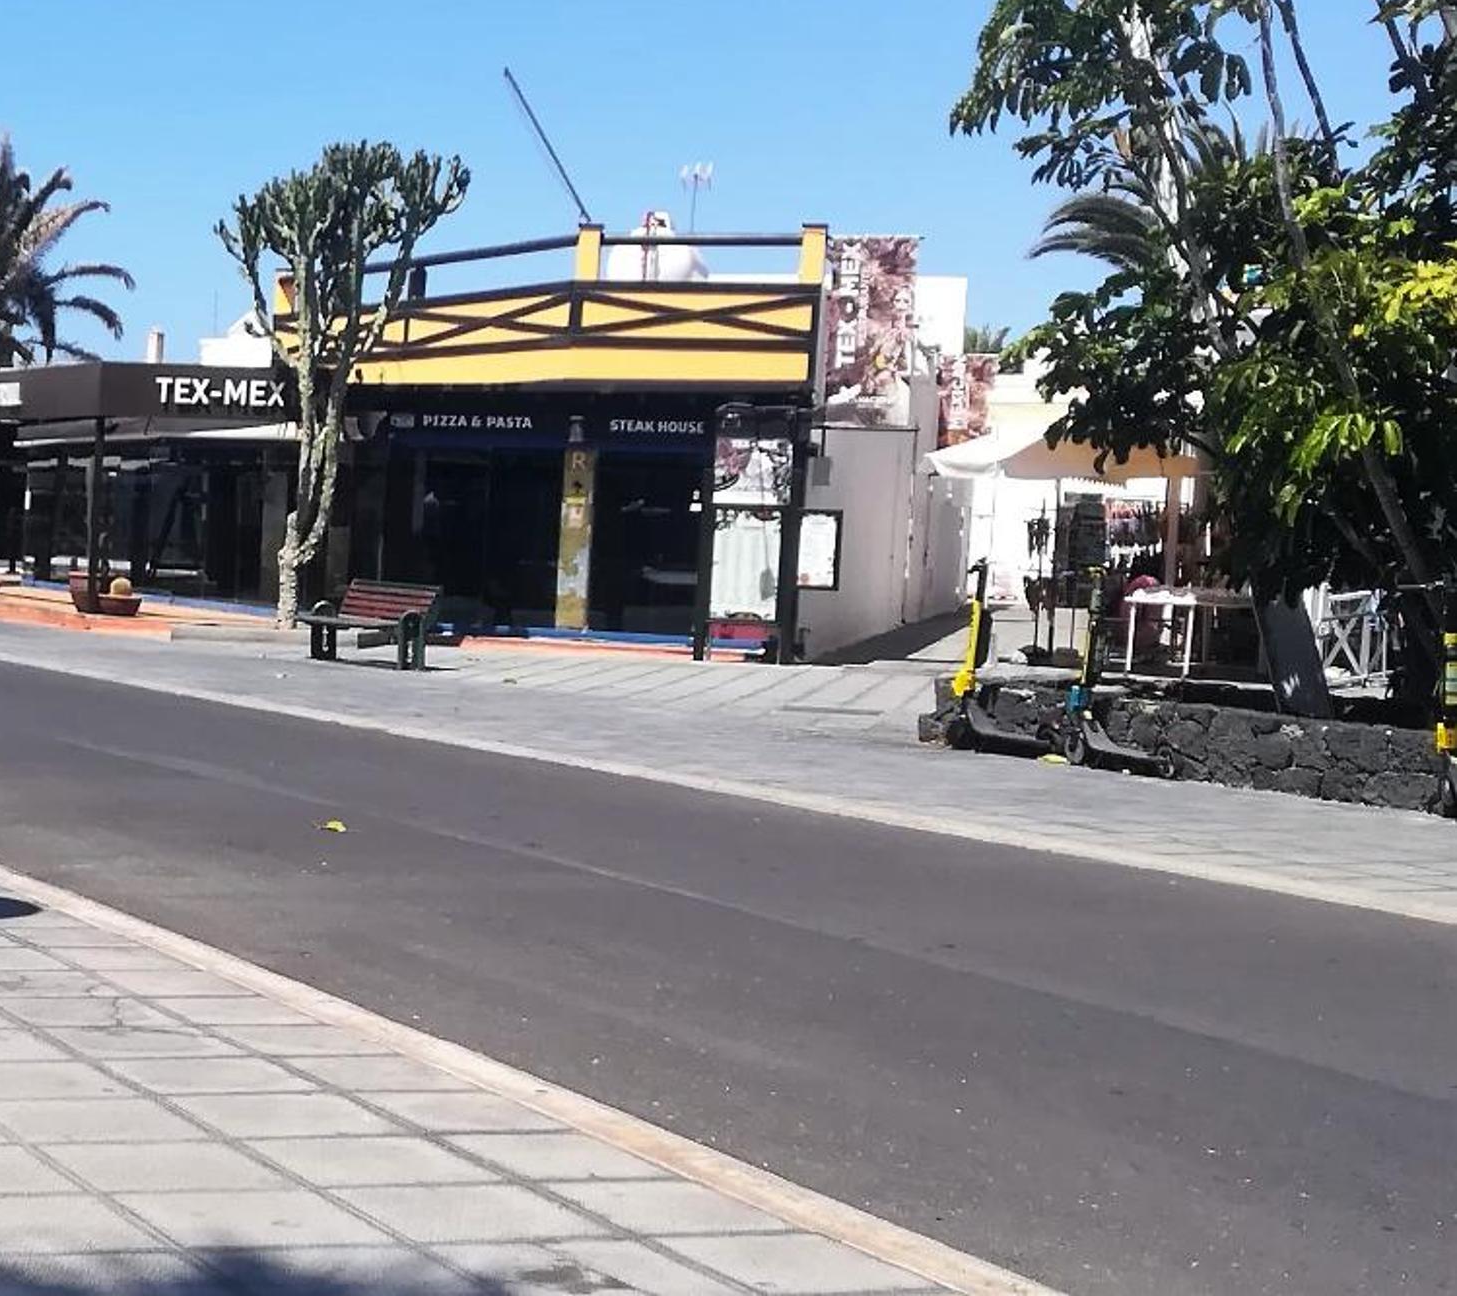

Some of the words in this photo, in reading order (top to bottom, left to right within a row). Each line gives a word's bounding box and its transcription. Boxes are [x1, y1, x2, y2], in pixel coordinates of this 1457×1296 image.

[155, 376, 286, 407] TEX-MEX
[422, 415, 468, 427] PIZZA
[471, 415, 482, 427] &
[486, 416, 533, 429] PASTA
[609, 419, 655, 432] STEAK
[657, 421, 705, 434] HOUSE
